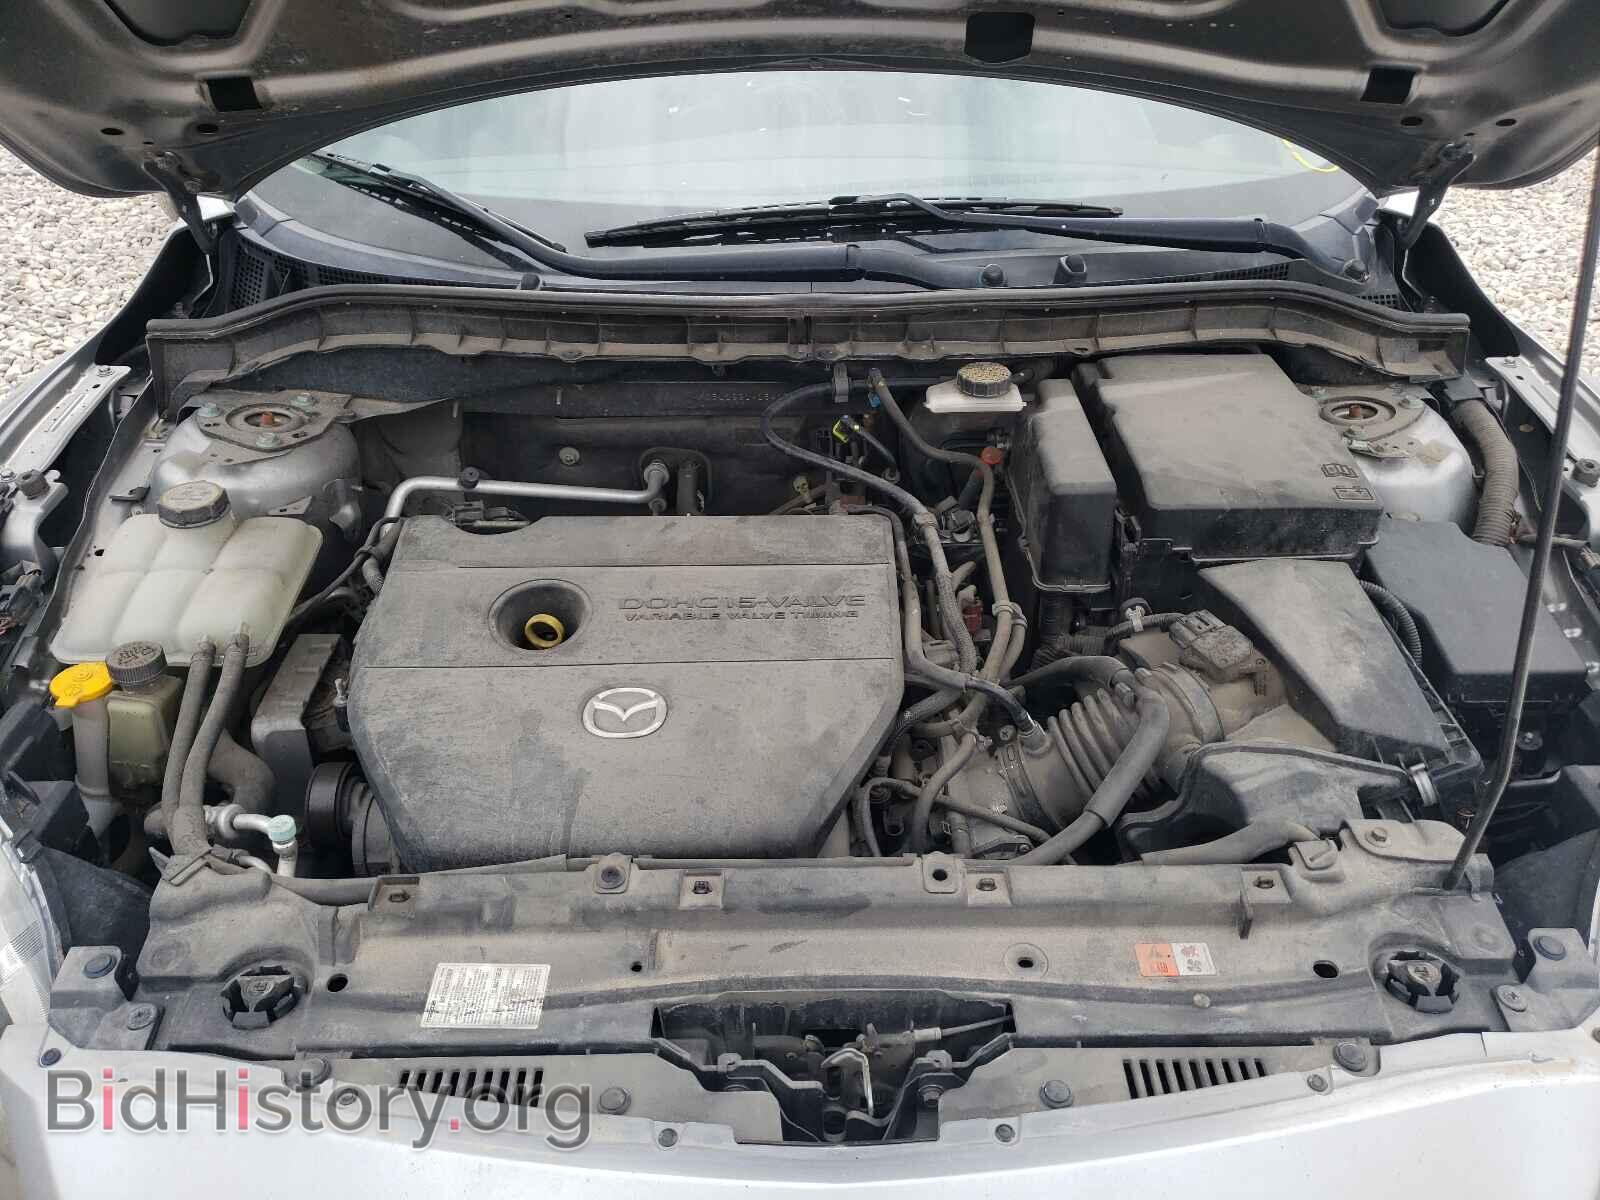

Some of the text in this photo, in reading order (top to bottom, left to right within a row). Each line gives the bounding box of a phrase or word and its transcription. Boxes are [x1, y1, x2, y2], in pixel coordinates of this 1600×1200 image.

[619, 596, 719, 610] DOHC
[623, 610, 859, 622] VARIABLE VALVE TIMING
